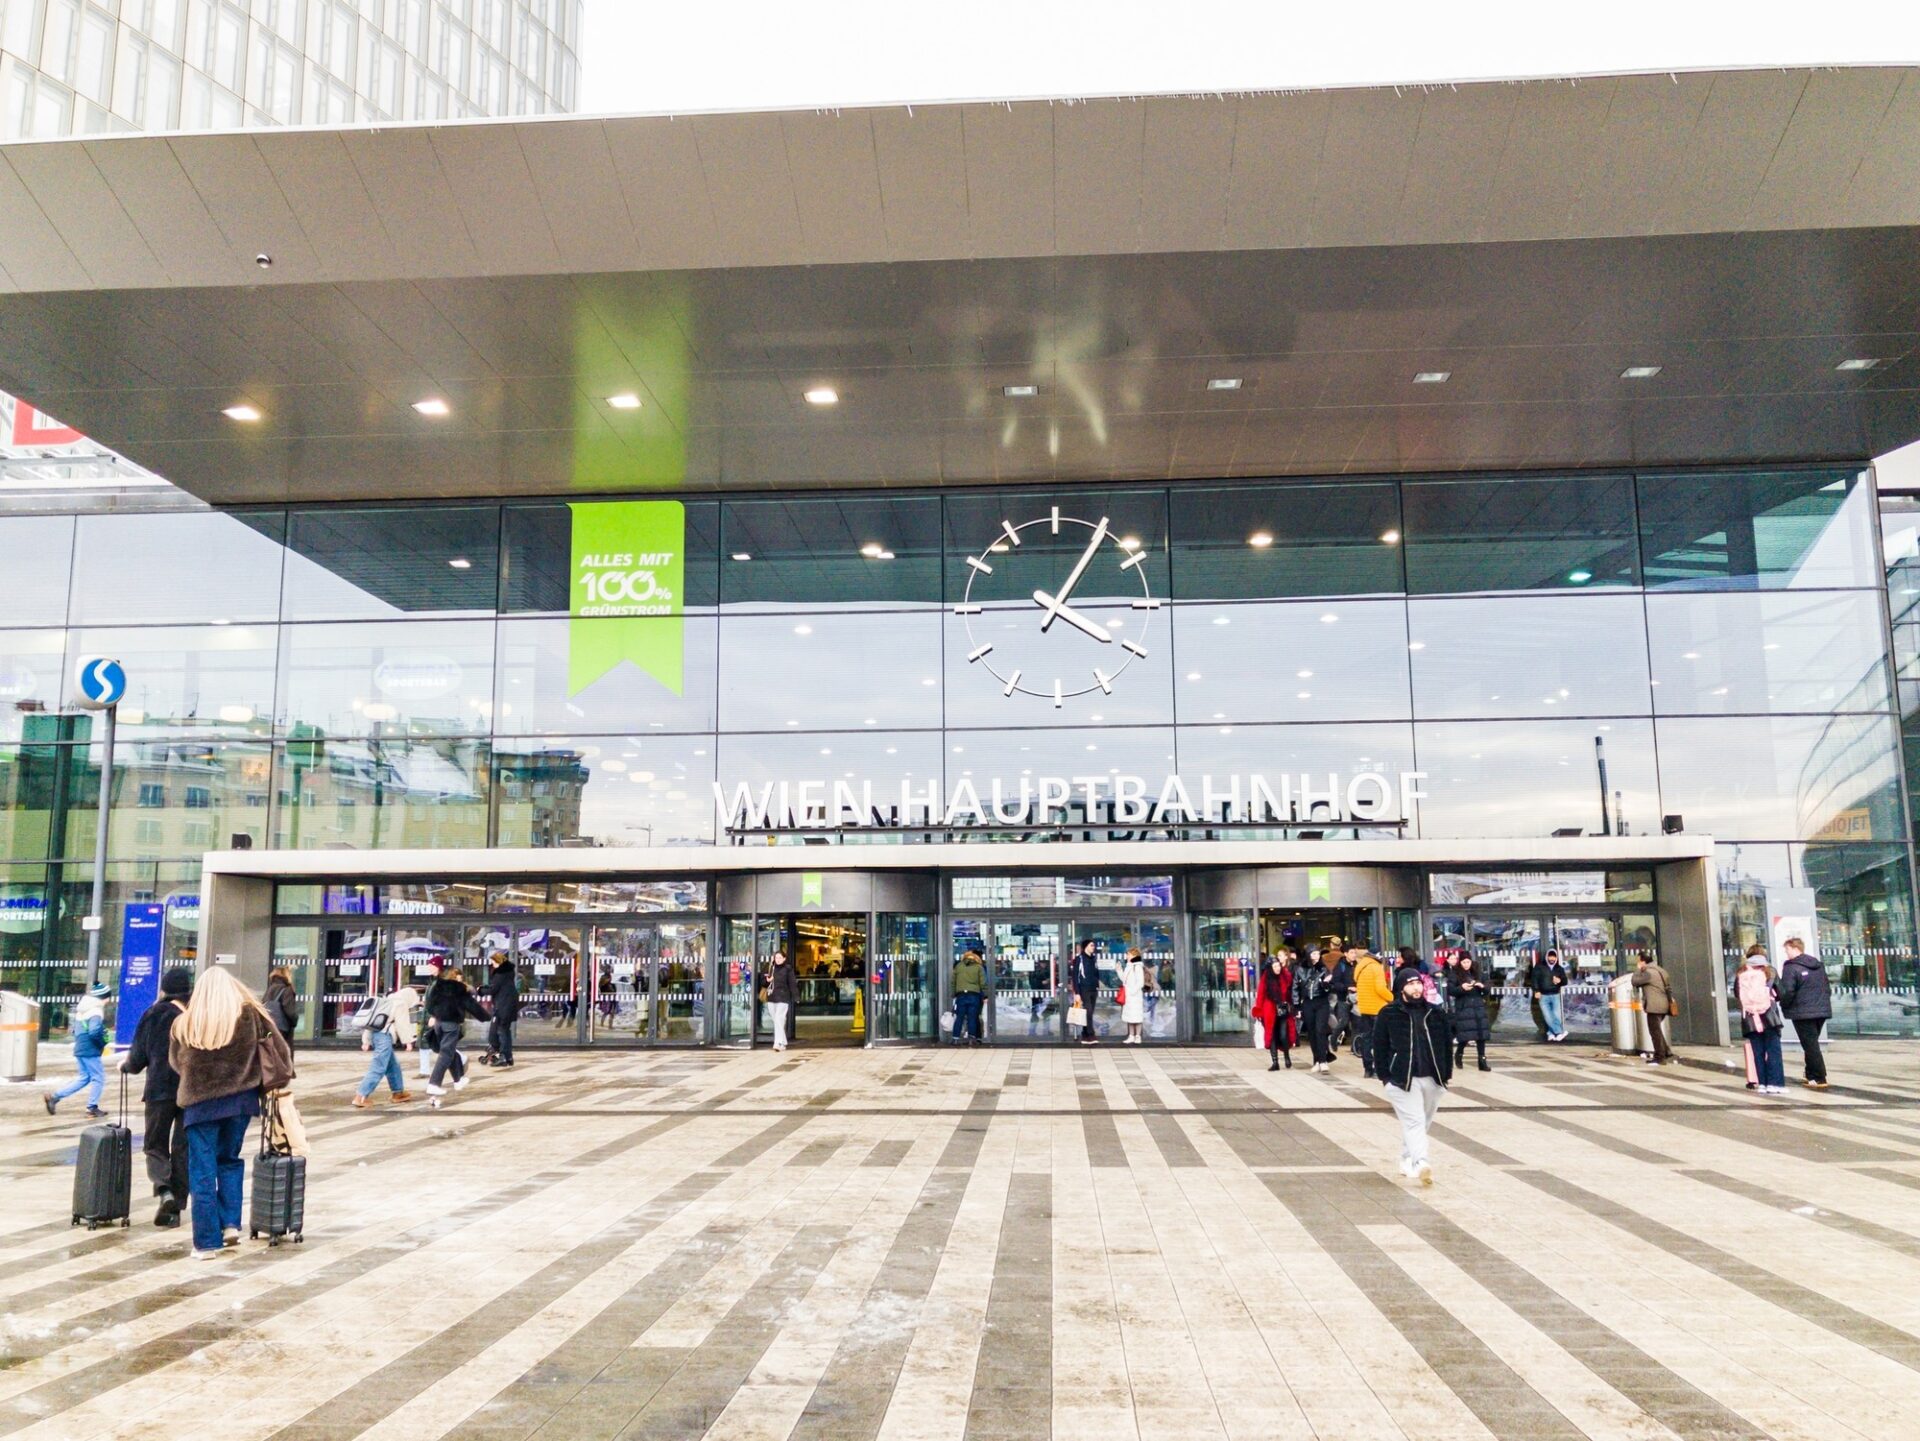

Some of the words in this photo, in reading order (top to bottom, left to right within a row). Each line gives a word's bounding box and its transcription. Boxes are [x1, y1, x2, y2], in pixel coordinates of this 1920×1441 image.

[580, 554, 633, 567] ALLES
[638, 553, 674, 566] MIT
[579, 570, 672, 602] 100%
[580, 604, 672, 616] GRÜNSTROM
[712, 780, 872, 828] WIEN
[901, 772, 1428, 828] HAUPTBAHNHOF
